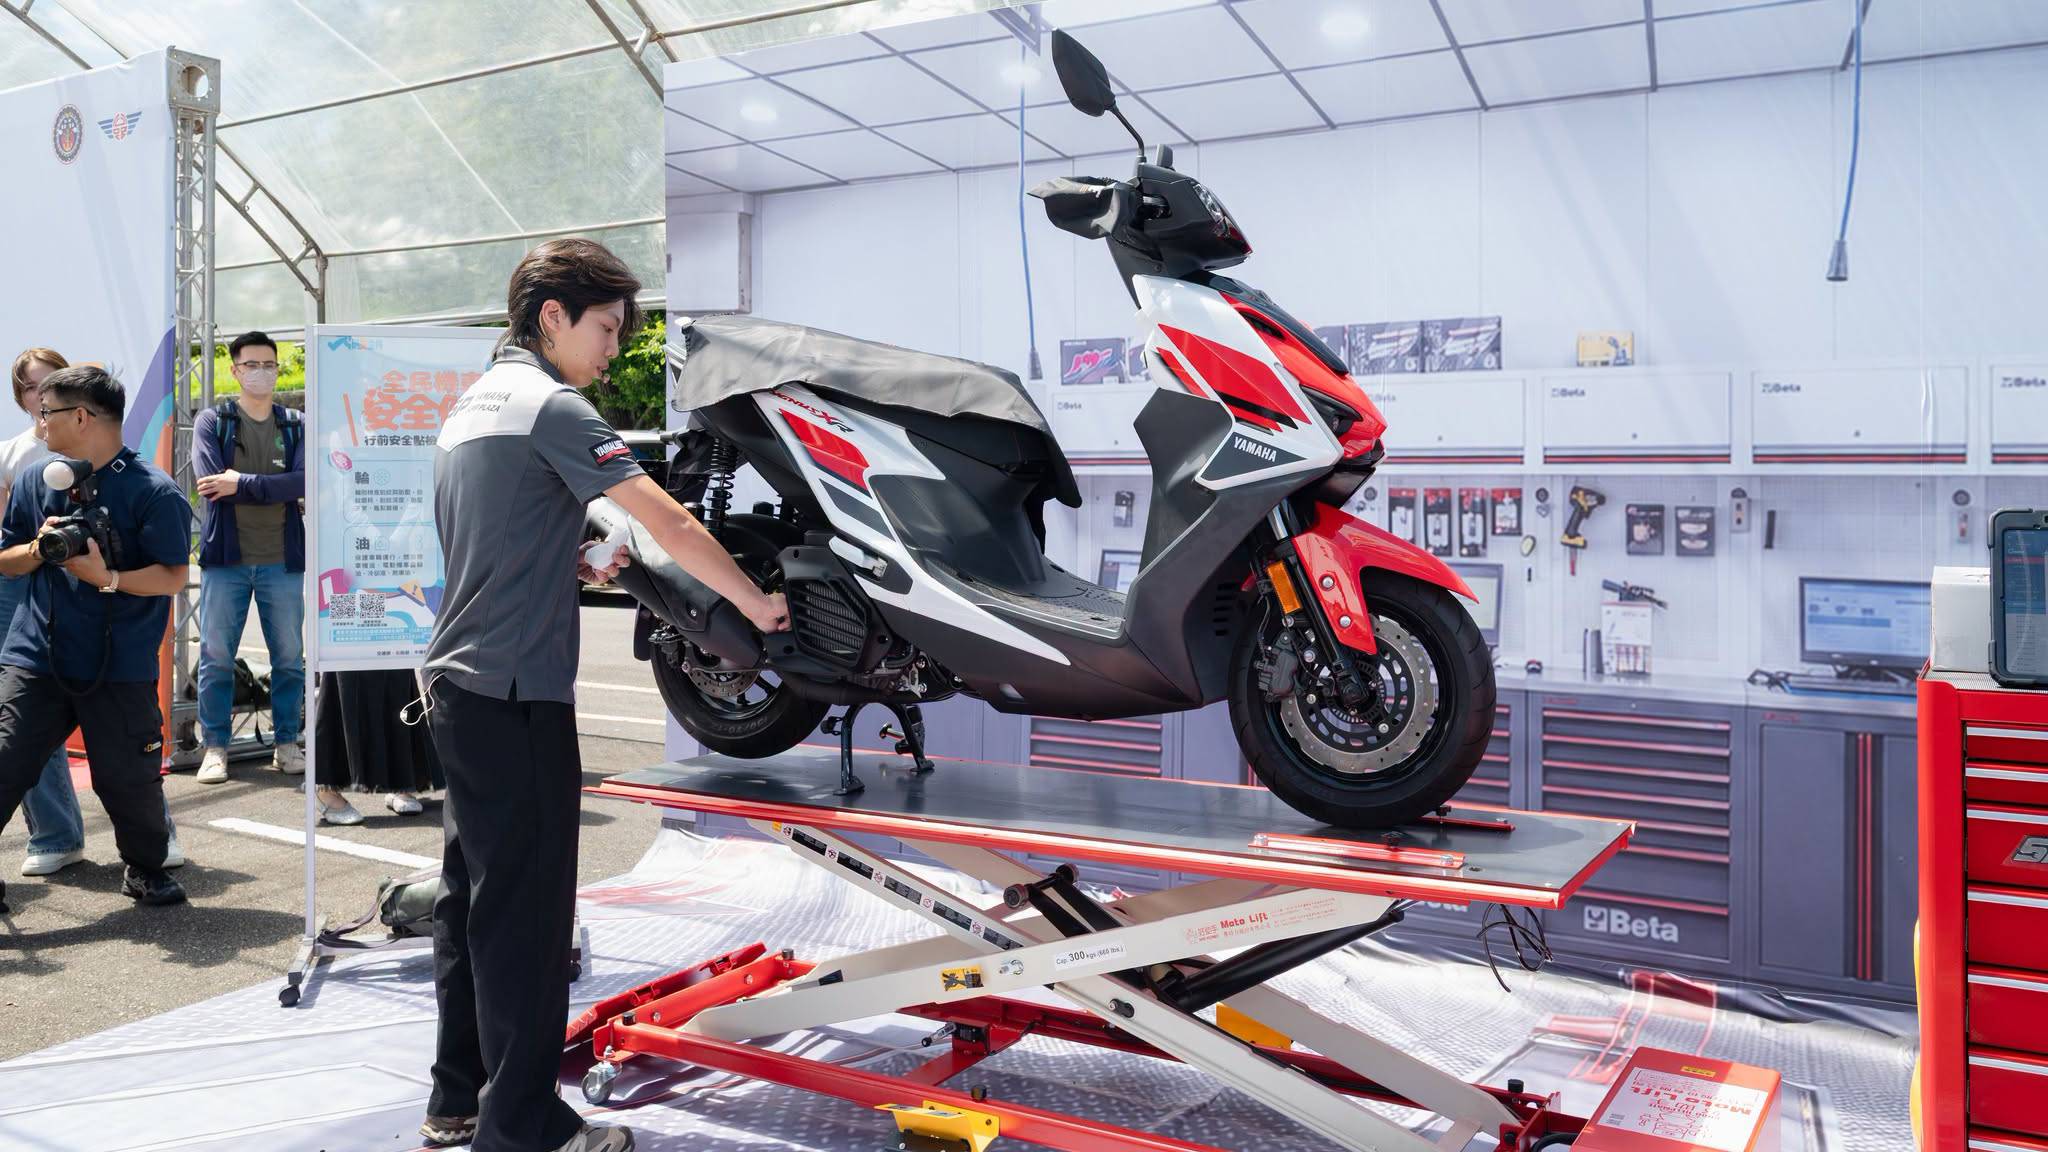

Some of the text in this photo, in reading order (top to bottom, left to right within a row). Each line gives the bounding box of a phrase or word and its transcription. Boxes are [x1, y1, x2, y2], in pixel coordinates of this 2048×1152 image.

[1234, 436, 1277, 463] YAMAHA
[355, 537, 370, 551] 油
[1220, 911, 1269, 929] Moto Lift
[1609, 908, 1679, 943] Beta
[1069, 951, 1086, 962] 300
